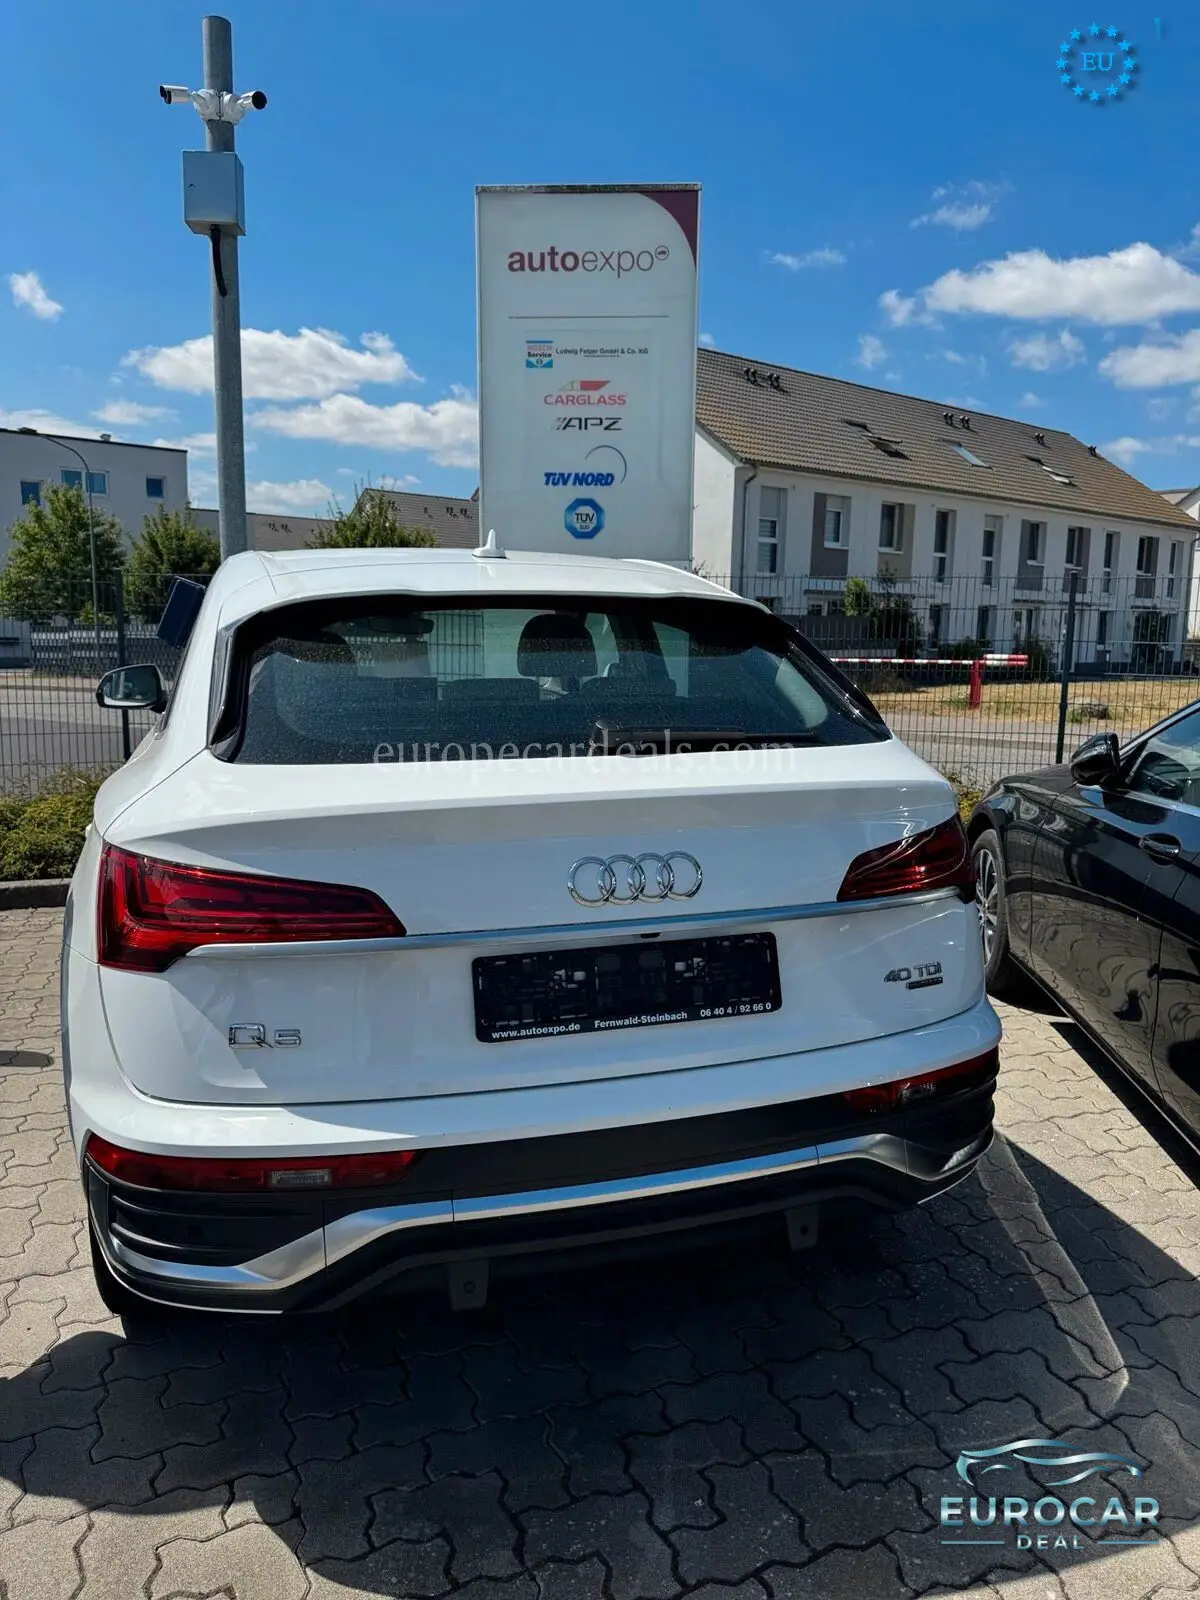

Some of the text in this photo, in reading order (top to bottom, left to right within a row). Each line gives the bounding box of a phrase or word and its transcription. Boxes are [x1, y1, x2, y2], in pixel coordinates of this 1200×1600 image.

[507, 246, 655, 278] autoexpo
[544, 394, 626, 405] CARGLASS
[544, 472, 615, 486] TÜV NORD
[884, 962, 942, 982] 40 TDI
[491, 1022, 581, 1039] www.autoexpo.de
[594, 1012, 688, 1029] Fernwald-Steinbach
[700, 1008, 712, 1017] 06
[713, 1007, 725, 1016] 40
[726, 1006, 733, 1014] 4
[739, 1004, 751, 1013] 92
[753, 1003, 764, 1012] 66
[765, 1002, 772, 1010] 0
[229, 1022, 301, 1049] Q5
